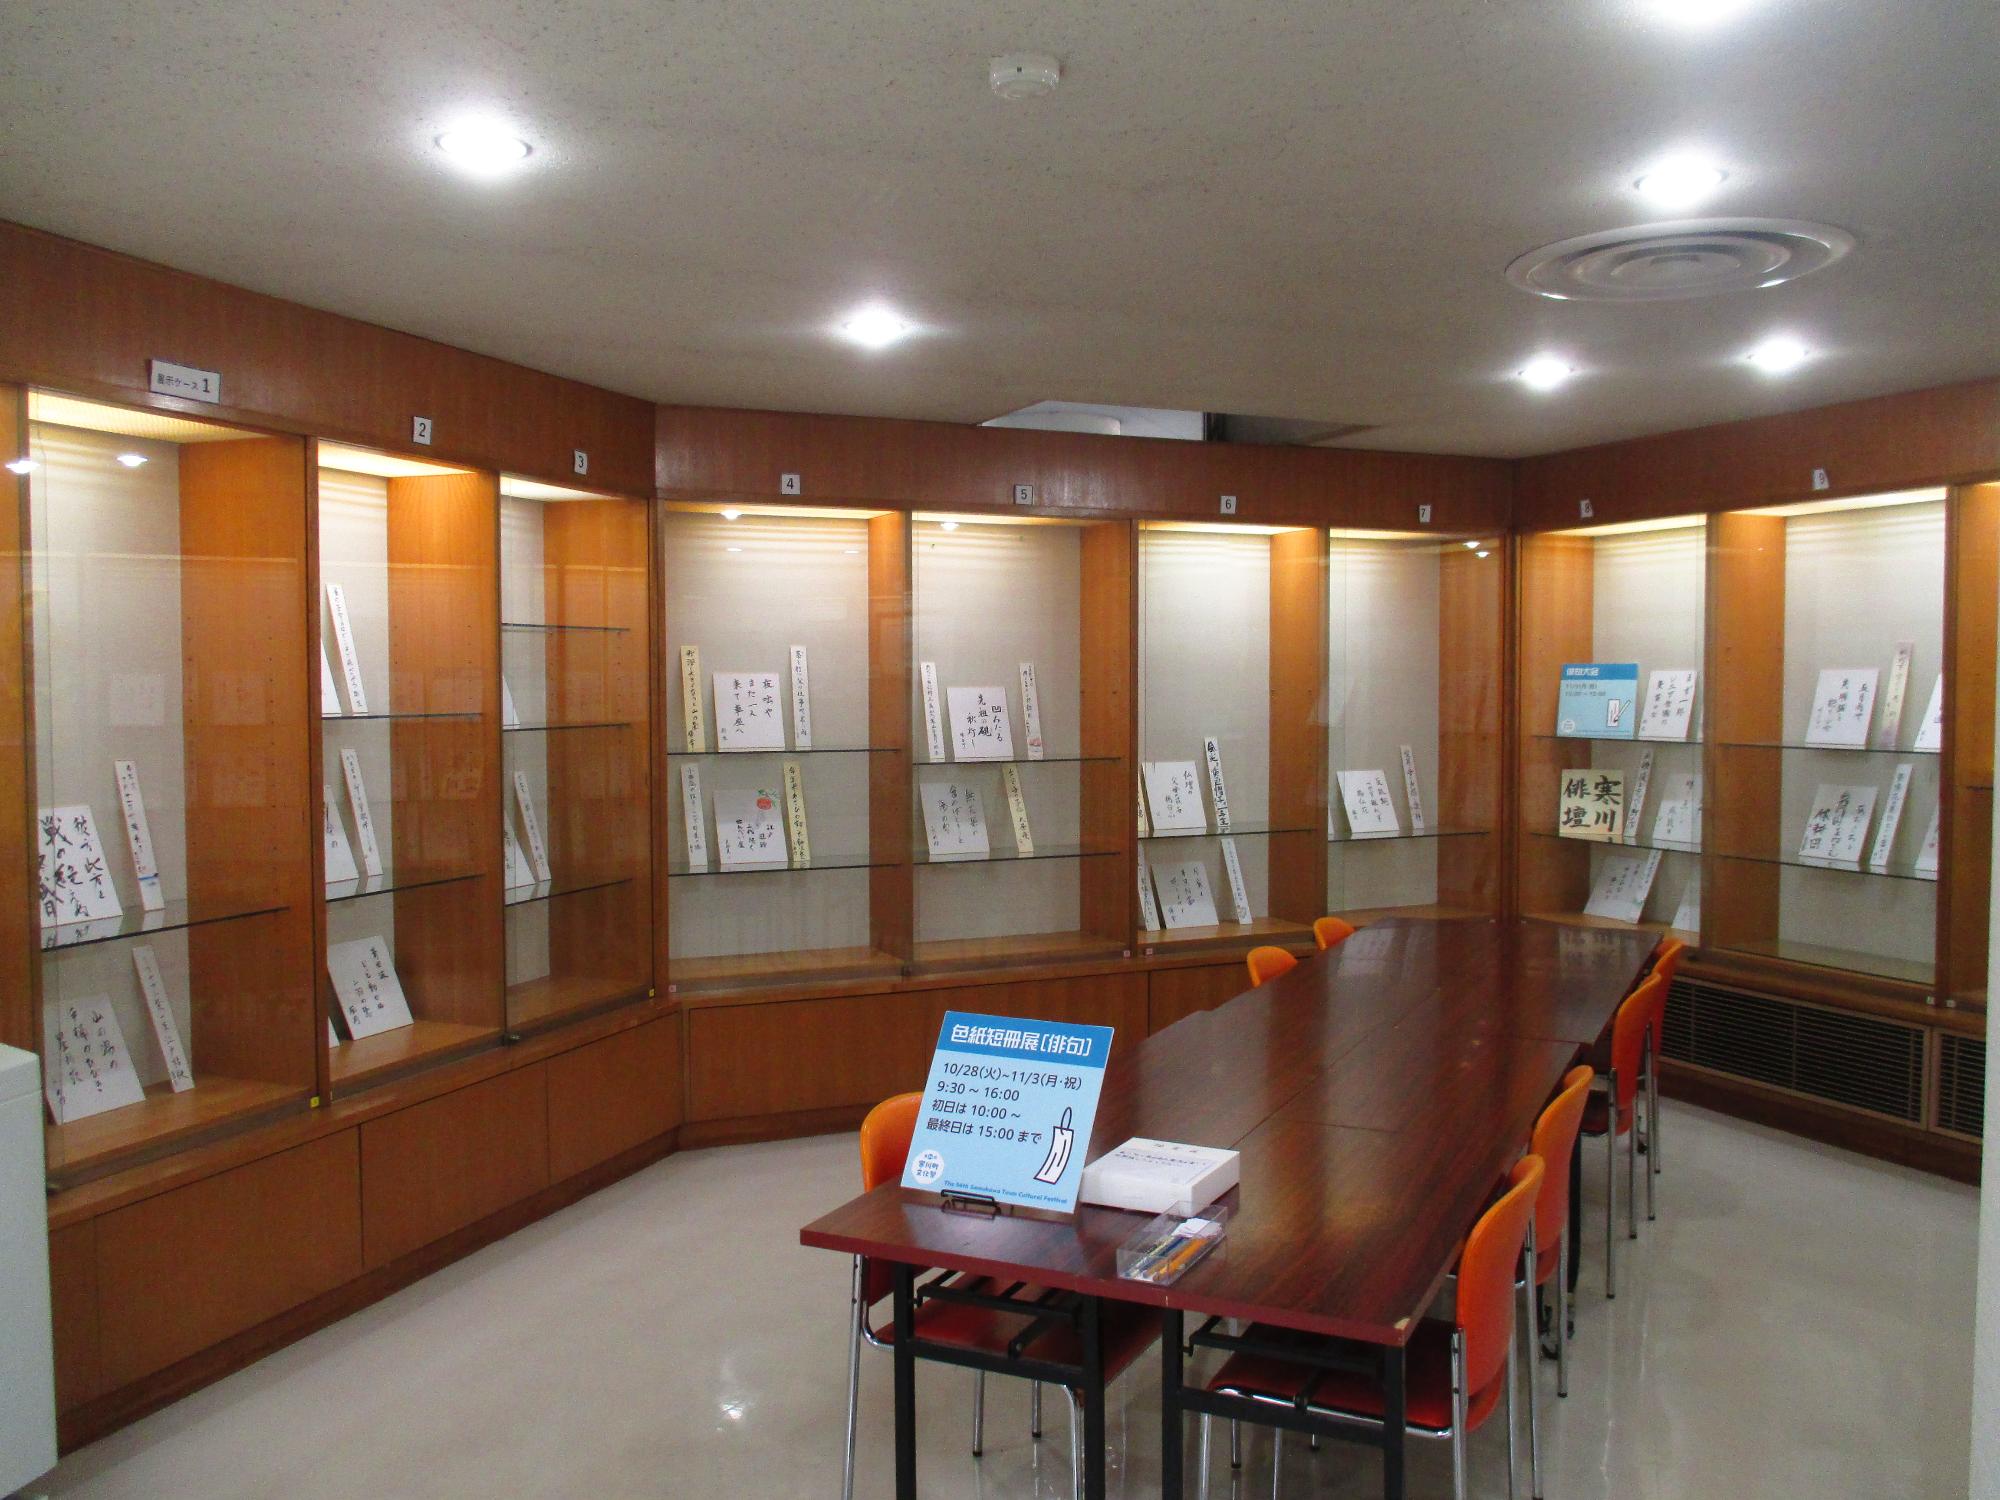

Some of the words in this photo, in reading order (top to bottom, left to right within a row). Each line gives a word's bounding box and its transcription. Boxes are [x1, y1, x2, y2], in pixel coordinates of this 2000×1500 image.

[157, 373, 199, 390] 展示ケース
[203, 378, 210, 393] 1
[1591, 774, 1622, 833] 寒川
[936, 1080, 966, 1095] 9:30
[984, 1086, 1020, 1101] 16:00
[931, 1098, 967, 1114] 初日は
[971, 1103, 1007, 1119] 10:00
[926, 1117, 973, 1135] 最終日は
[978, 1125, 1014, 1140] 15:00
[1017, 1130, 1043, 1144] まで
